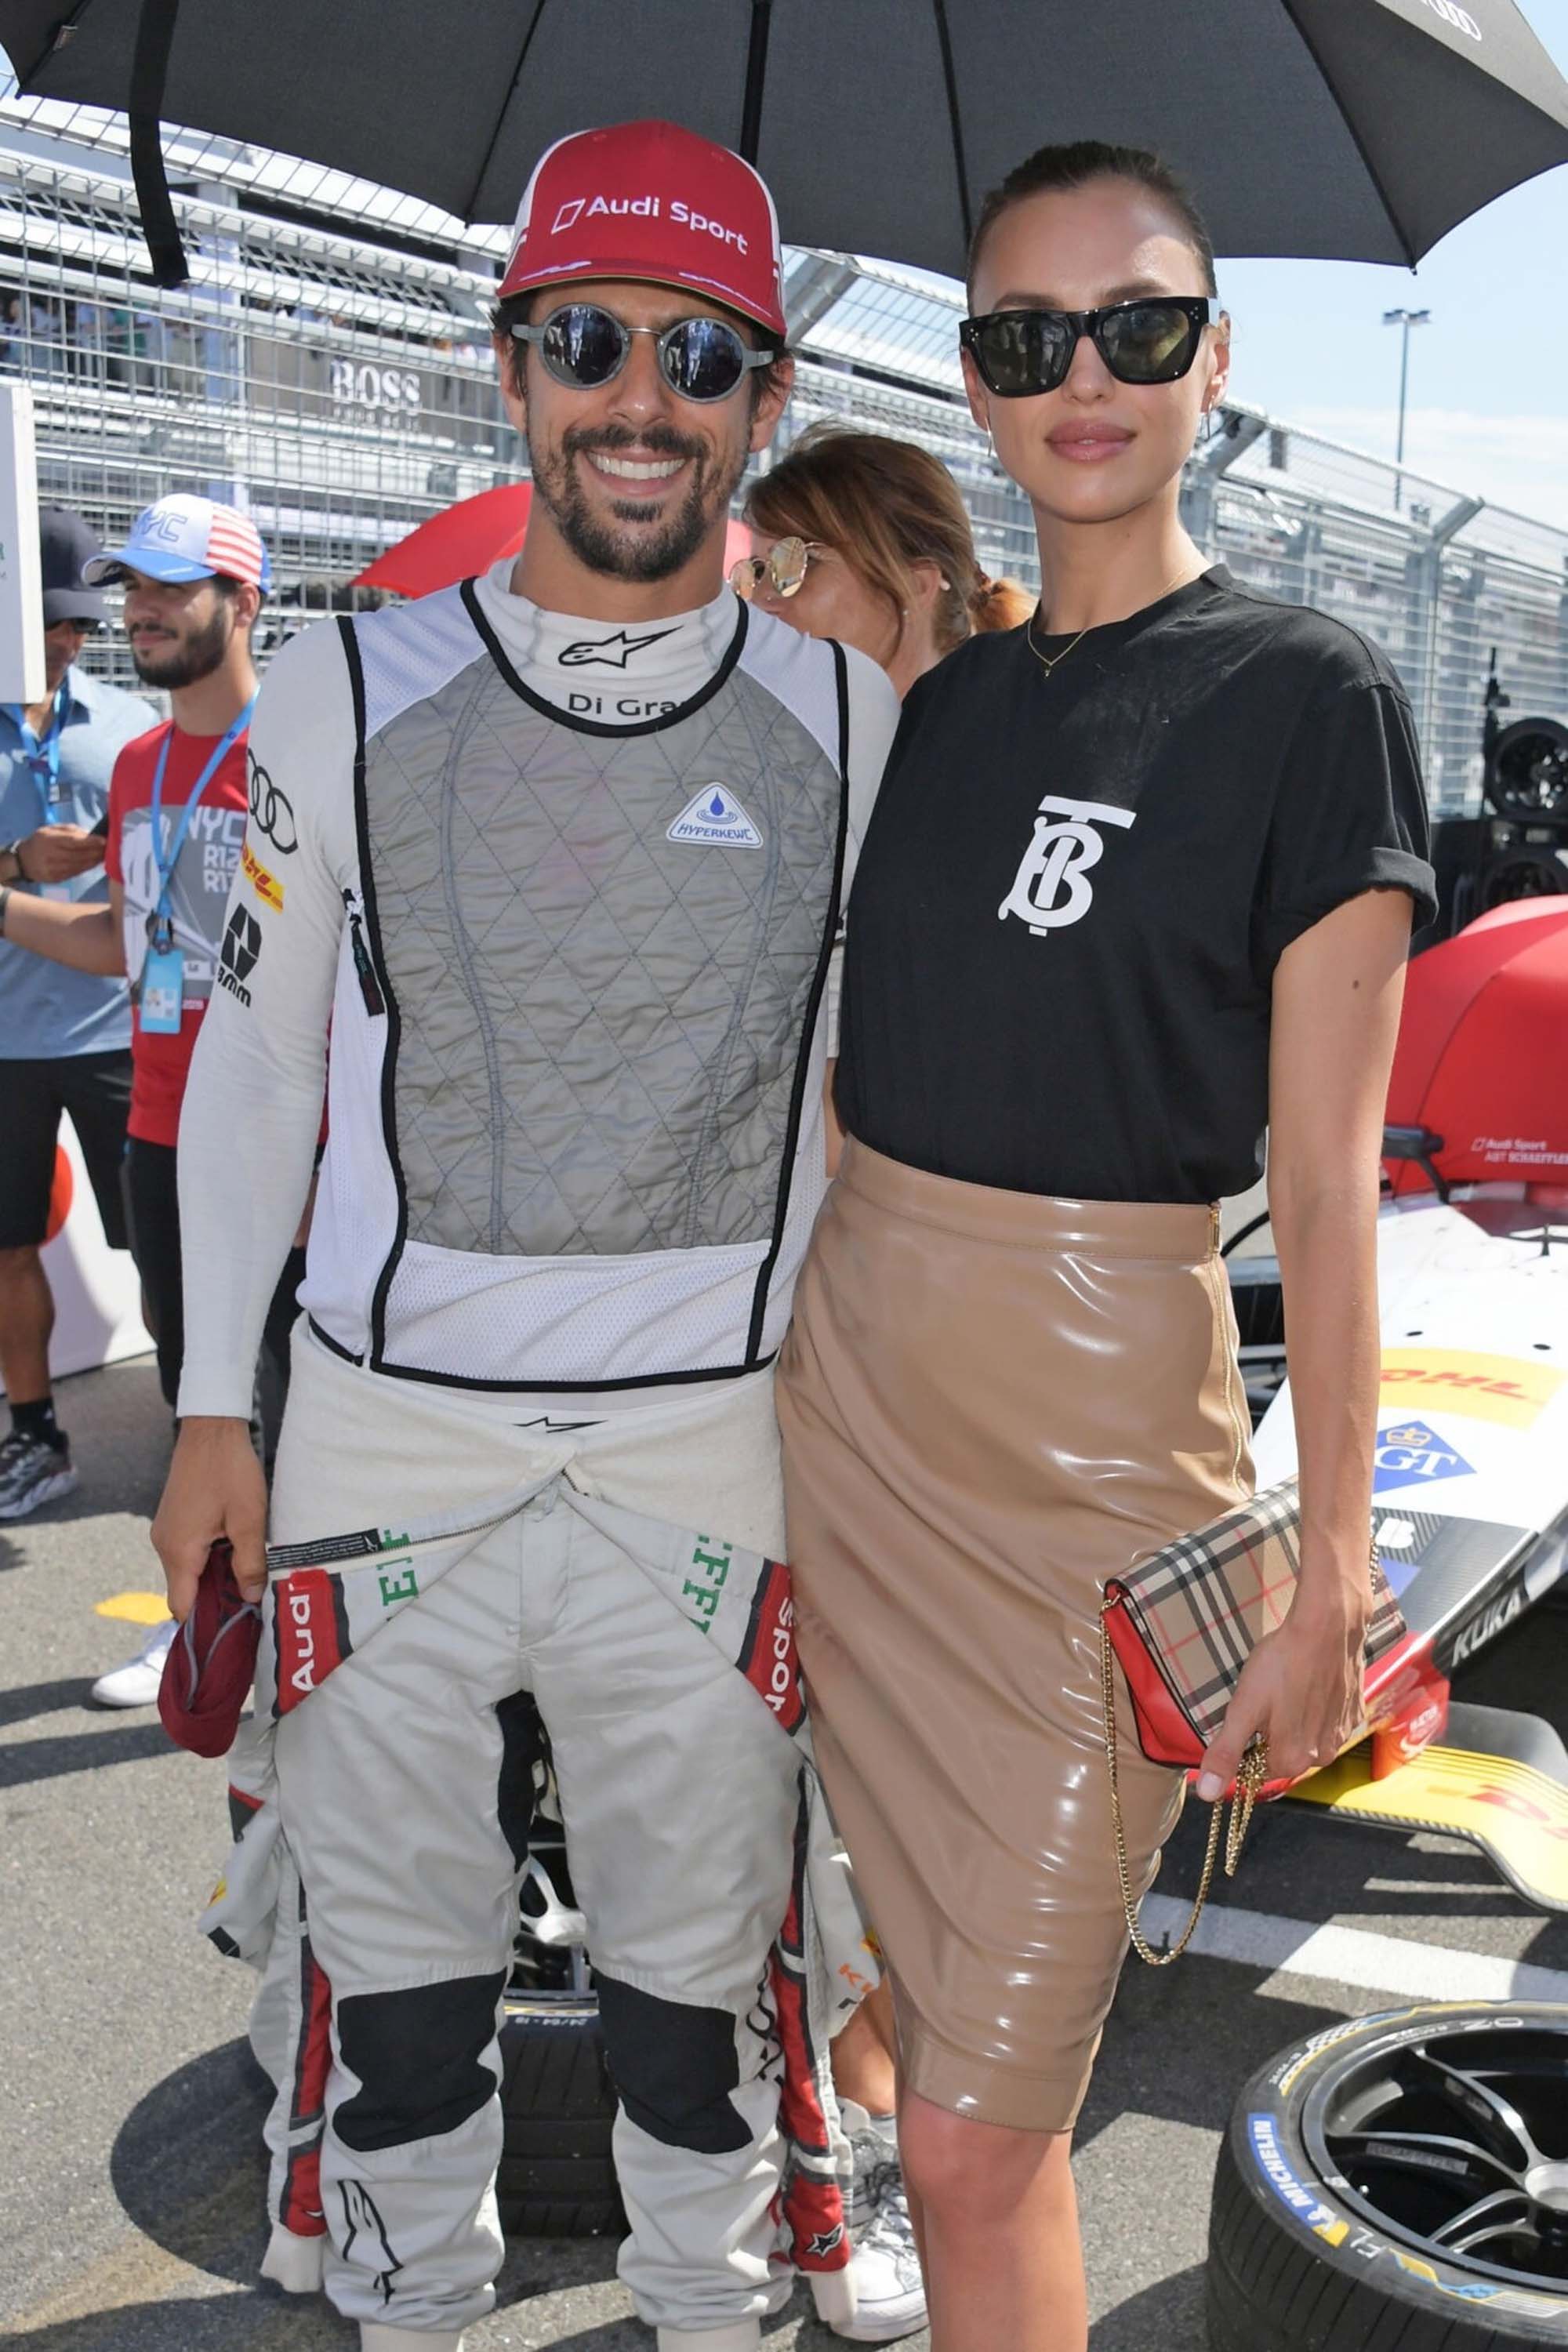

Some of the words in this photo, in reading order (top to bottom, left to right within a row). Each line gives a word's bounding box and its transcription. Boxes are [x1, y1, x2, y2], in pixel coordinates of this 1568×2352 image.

[586, 196, 660, 217] Audi
[670, 201, 749, 256] Sport
[331, 360, 422, 416] BOSS
[568, 693, 602, 714] Di
[1452, 1587, 1522, 1668] KUKA
[1254, 2120, 1314, 2208] MICHELIN
